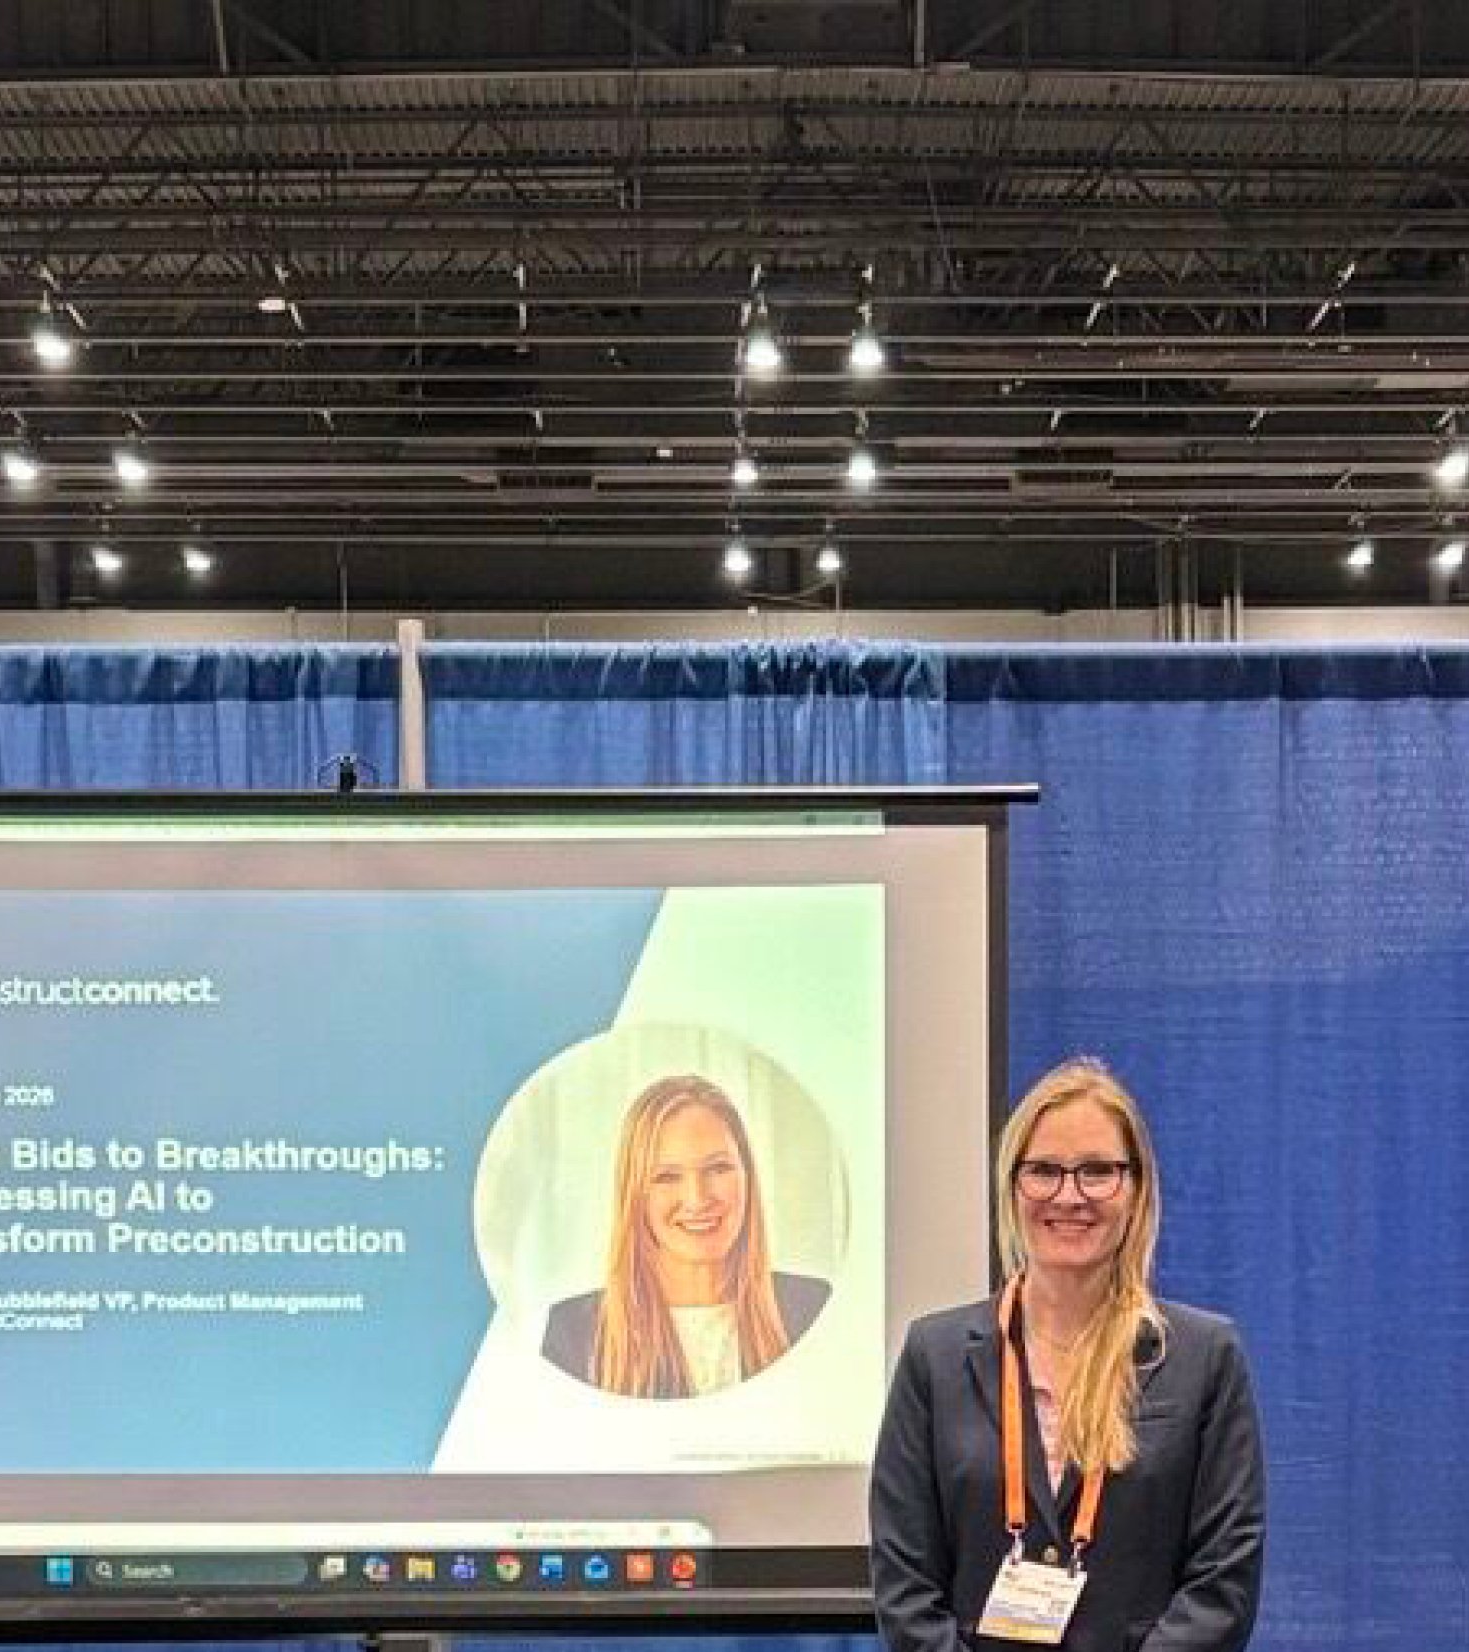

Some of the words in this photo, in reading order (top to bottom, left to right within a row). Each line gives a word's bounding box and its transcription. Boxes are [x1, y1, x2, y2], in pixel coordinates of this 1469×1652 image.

[10, 1137, 97, 1171] Bids
[105, 1140, 145, 1171] to
[156, 1137, 444, 1178] Breakthroughs:
[124, 1179, 165, 1211] AI
[173, 1180, 214, 1211] to
[108, 1221, 406, 1253] Preconstruction
[142, 1290, 226, 1311] Product
[229, 1291, 364, 1315] Management
